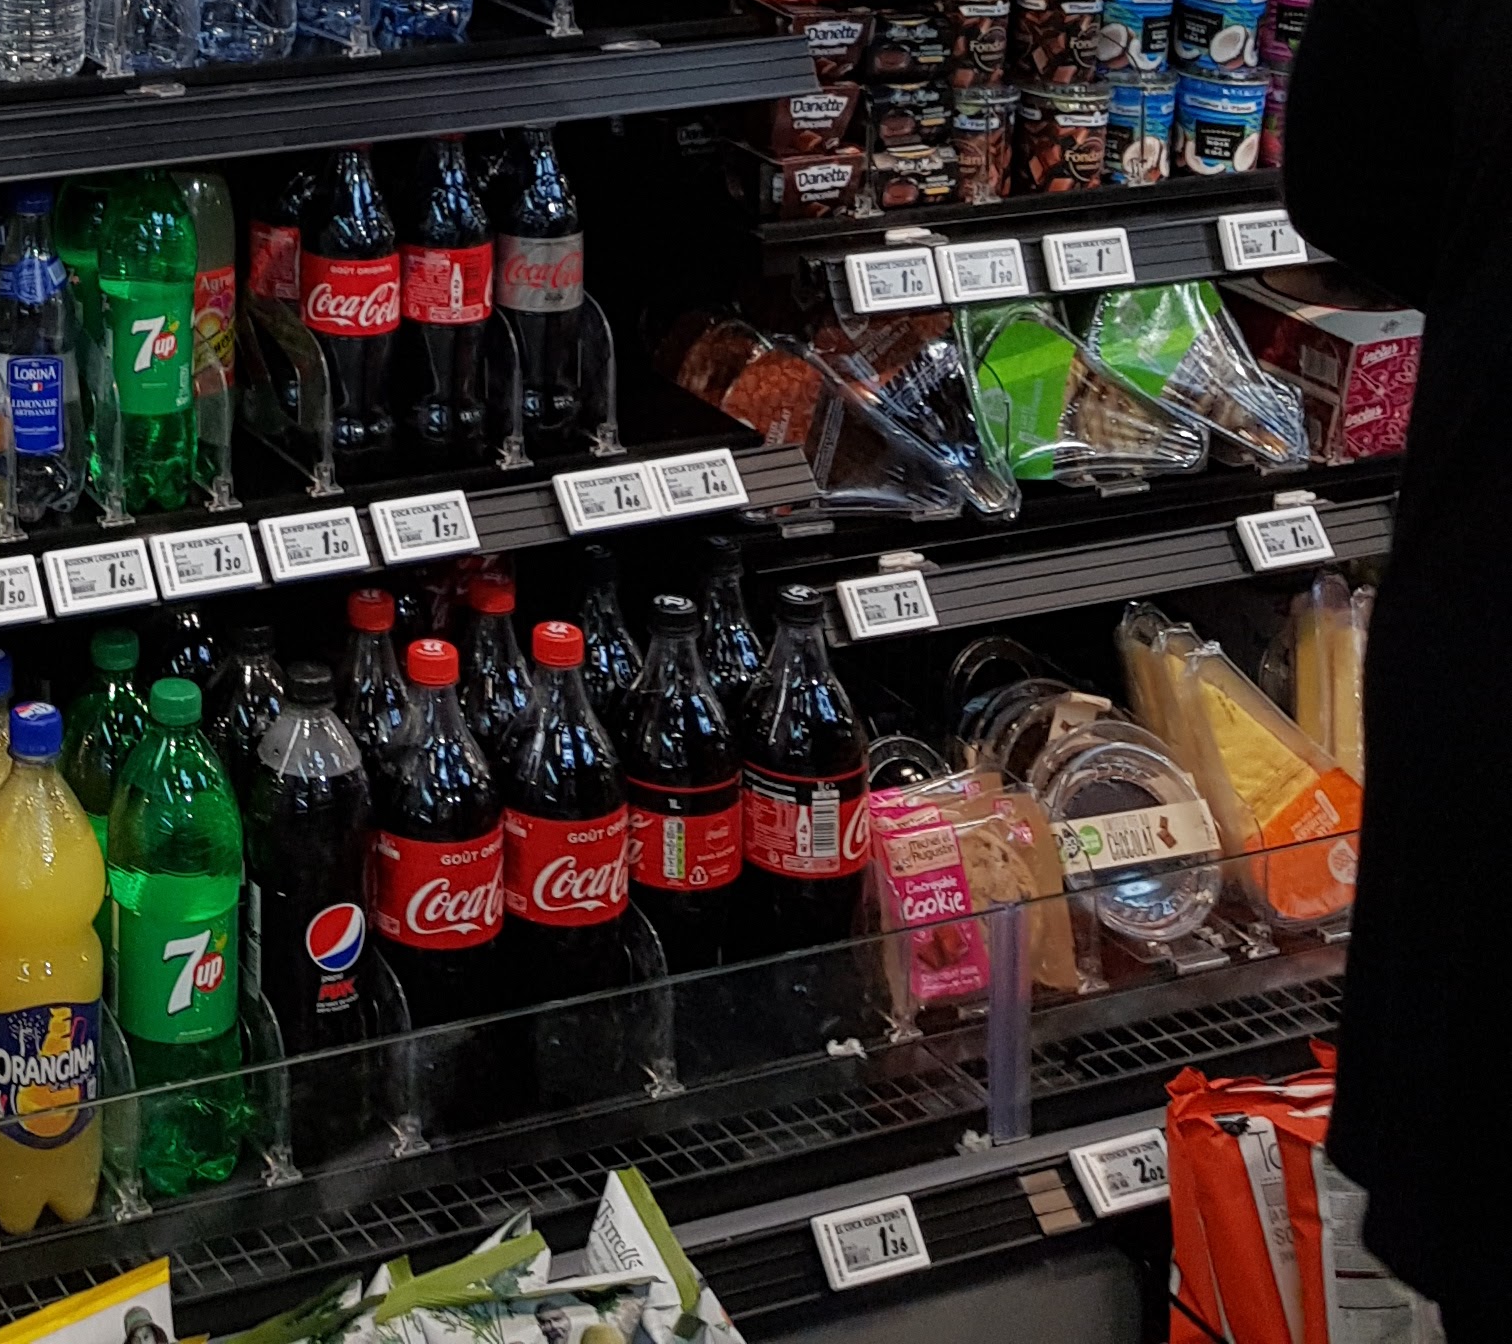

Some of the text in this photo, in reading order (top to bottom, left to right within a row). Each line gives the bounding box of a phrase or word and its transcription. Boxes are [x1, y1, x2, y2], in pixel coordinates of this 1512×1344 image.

[806, 24, 859, 45] Danette
[790, 97, 845, 116] Danette
[797, 166, 850, 187] Danette
[14, 365, 58, 381] LORINA
[566, 828, 606, 845] GOÛT
[440, 850, 479, 867] GOÛT
[903, 891, 967, 923] Cookie
